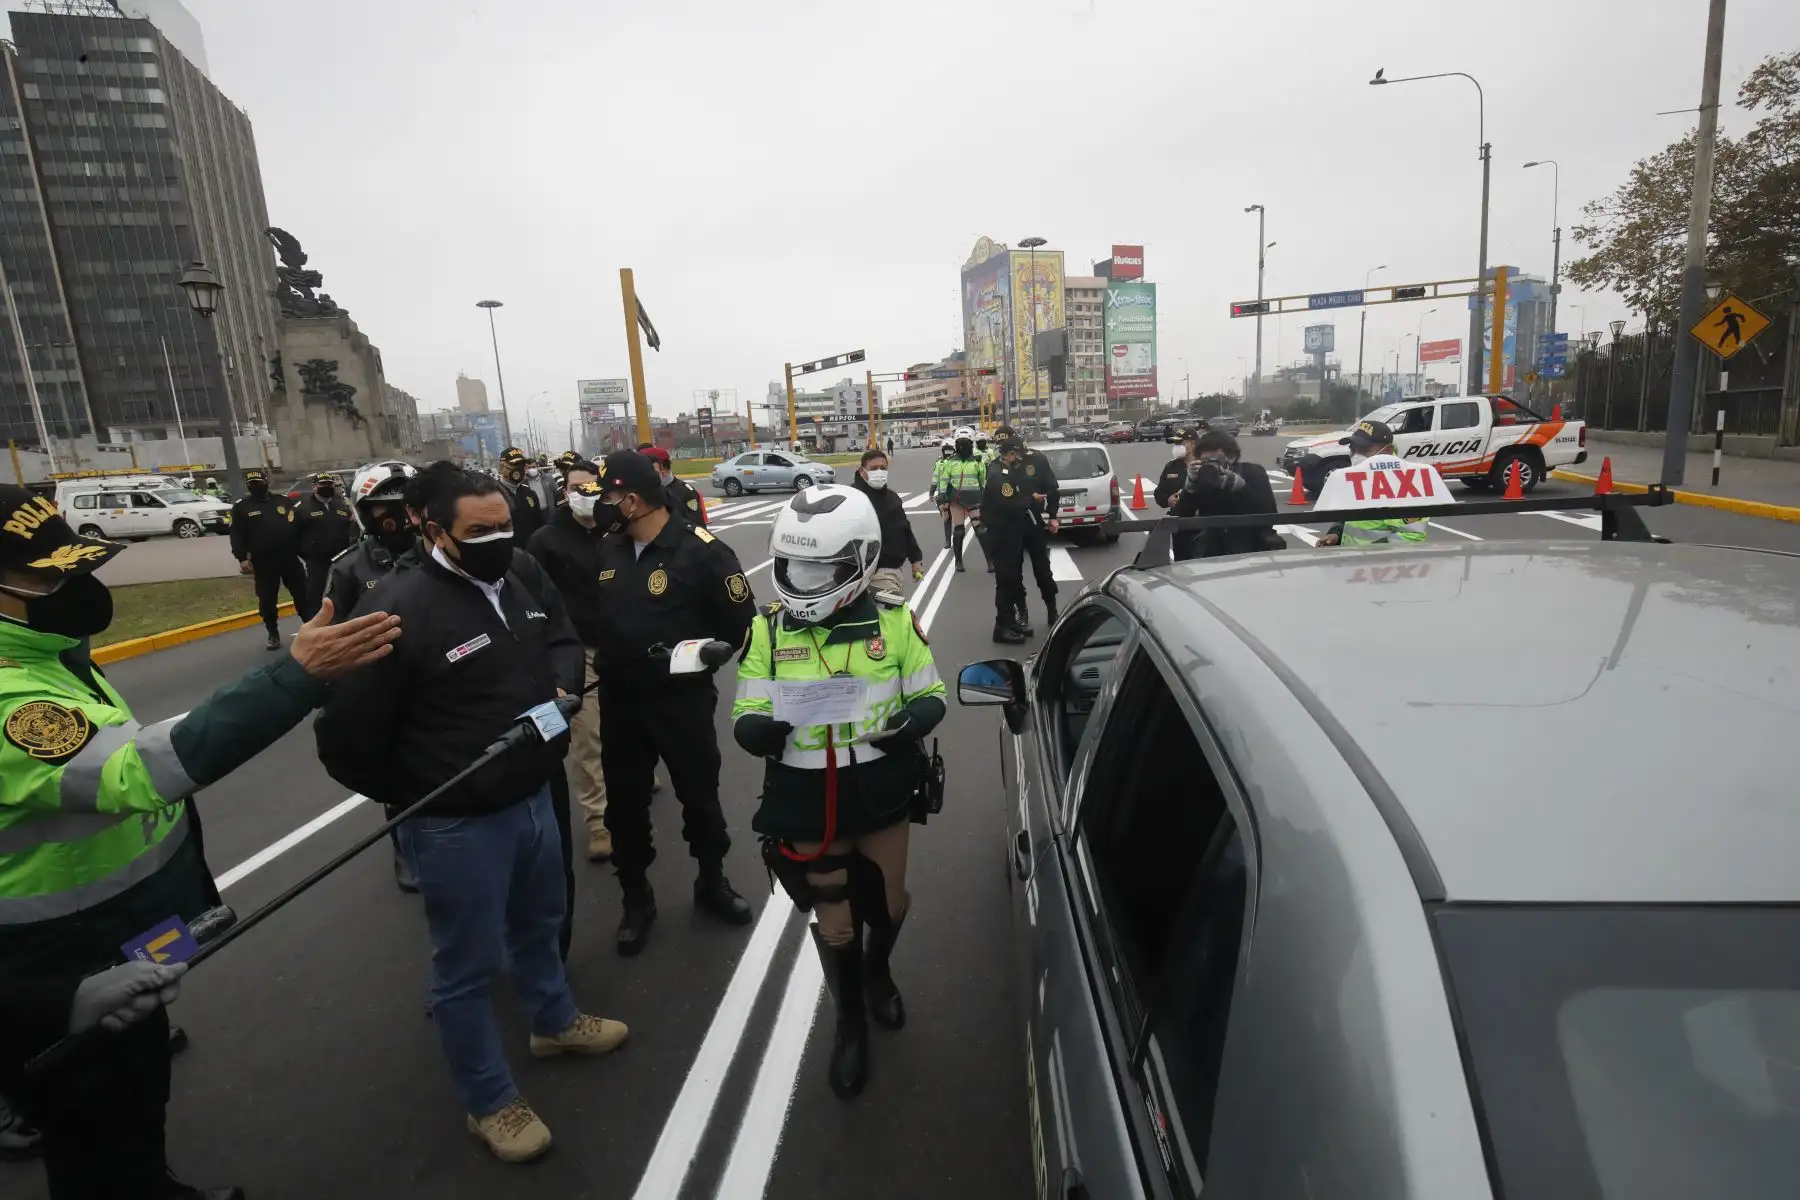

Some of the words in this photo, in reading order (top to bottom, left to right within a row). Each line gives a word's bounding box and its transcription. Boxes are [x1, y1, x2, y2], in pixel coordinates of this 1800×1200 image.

[1403, 439, 1482, 459] POLICIA
[1369, 461, 1401, 471] LIBRE
[1344, 468, 1435, 501] TAXI
[780, 532, 818, 549] POLICIA
